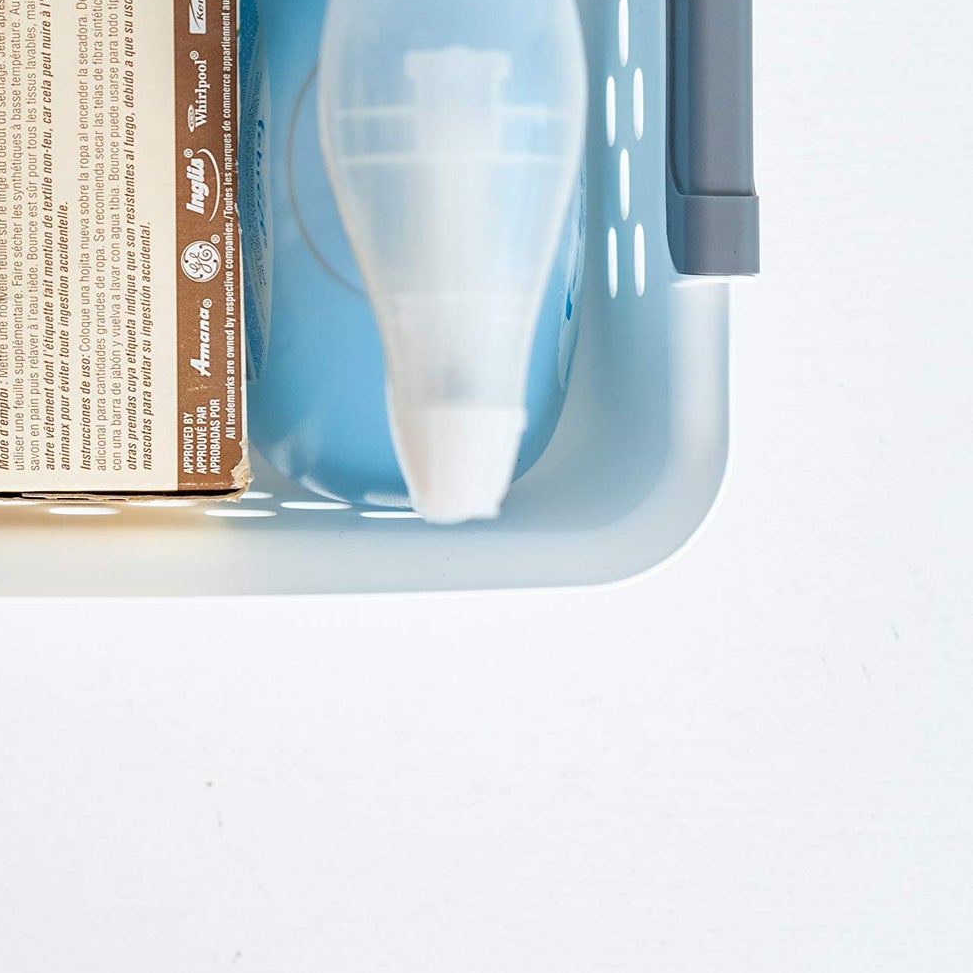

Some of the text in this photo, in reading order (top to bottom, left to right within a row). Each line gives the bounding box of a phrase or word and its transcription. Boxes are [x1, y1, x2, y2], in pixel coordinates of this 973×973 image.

[221, 13, 233, 71] appartiennent
[223, 74, 231, 118] commerce
[222, 121, 231, 131] de
[224, 133, 234, 170] marques
[223, 172, 232, 185] les
[224, 271, 236, 315] respective
[57, 202, 72, 470] animaux pour éviter toute ingestion accidentelle.
[224, 317, 236, 327] by
[224, 330, 234, 358] owned
[140, 222, 154, 470] mascotas para evitar su ingestión accidental.
[227, 360, 235, 374] are
[225, 376, 235, 425] trademarks
[183, 412, 194, 474] APPROVED BY
[195, 407, 207, 474] APPROUVÉ PAR
[210, 399, 220, 474] APROBADAS POR
[225, 427, 235, 439] All
